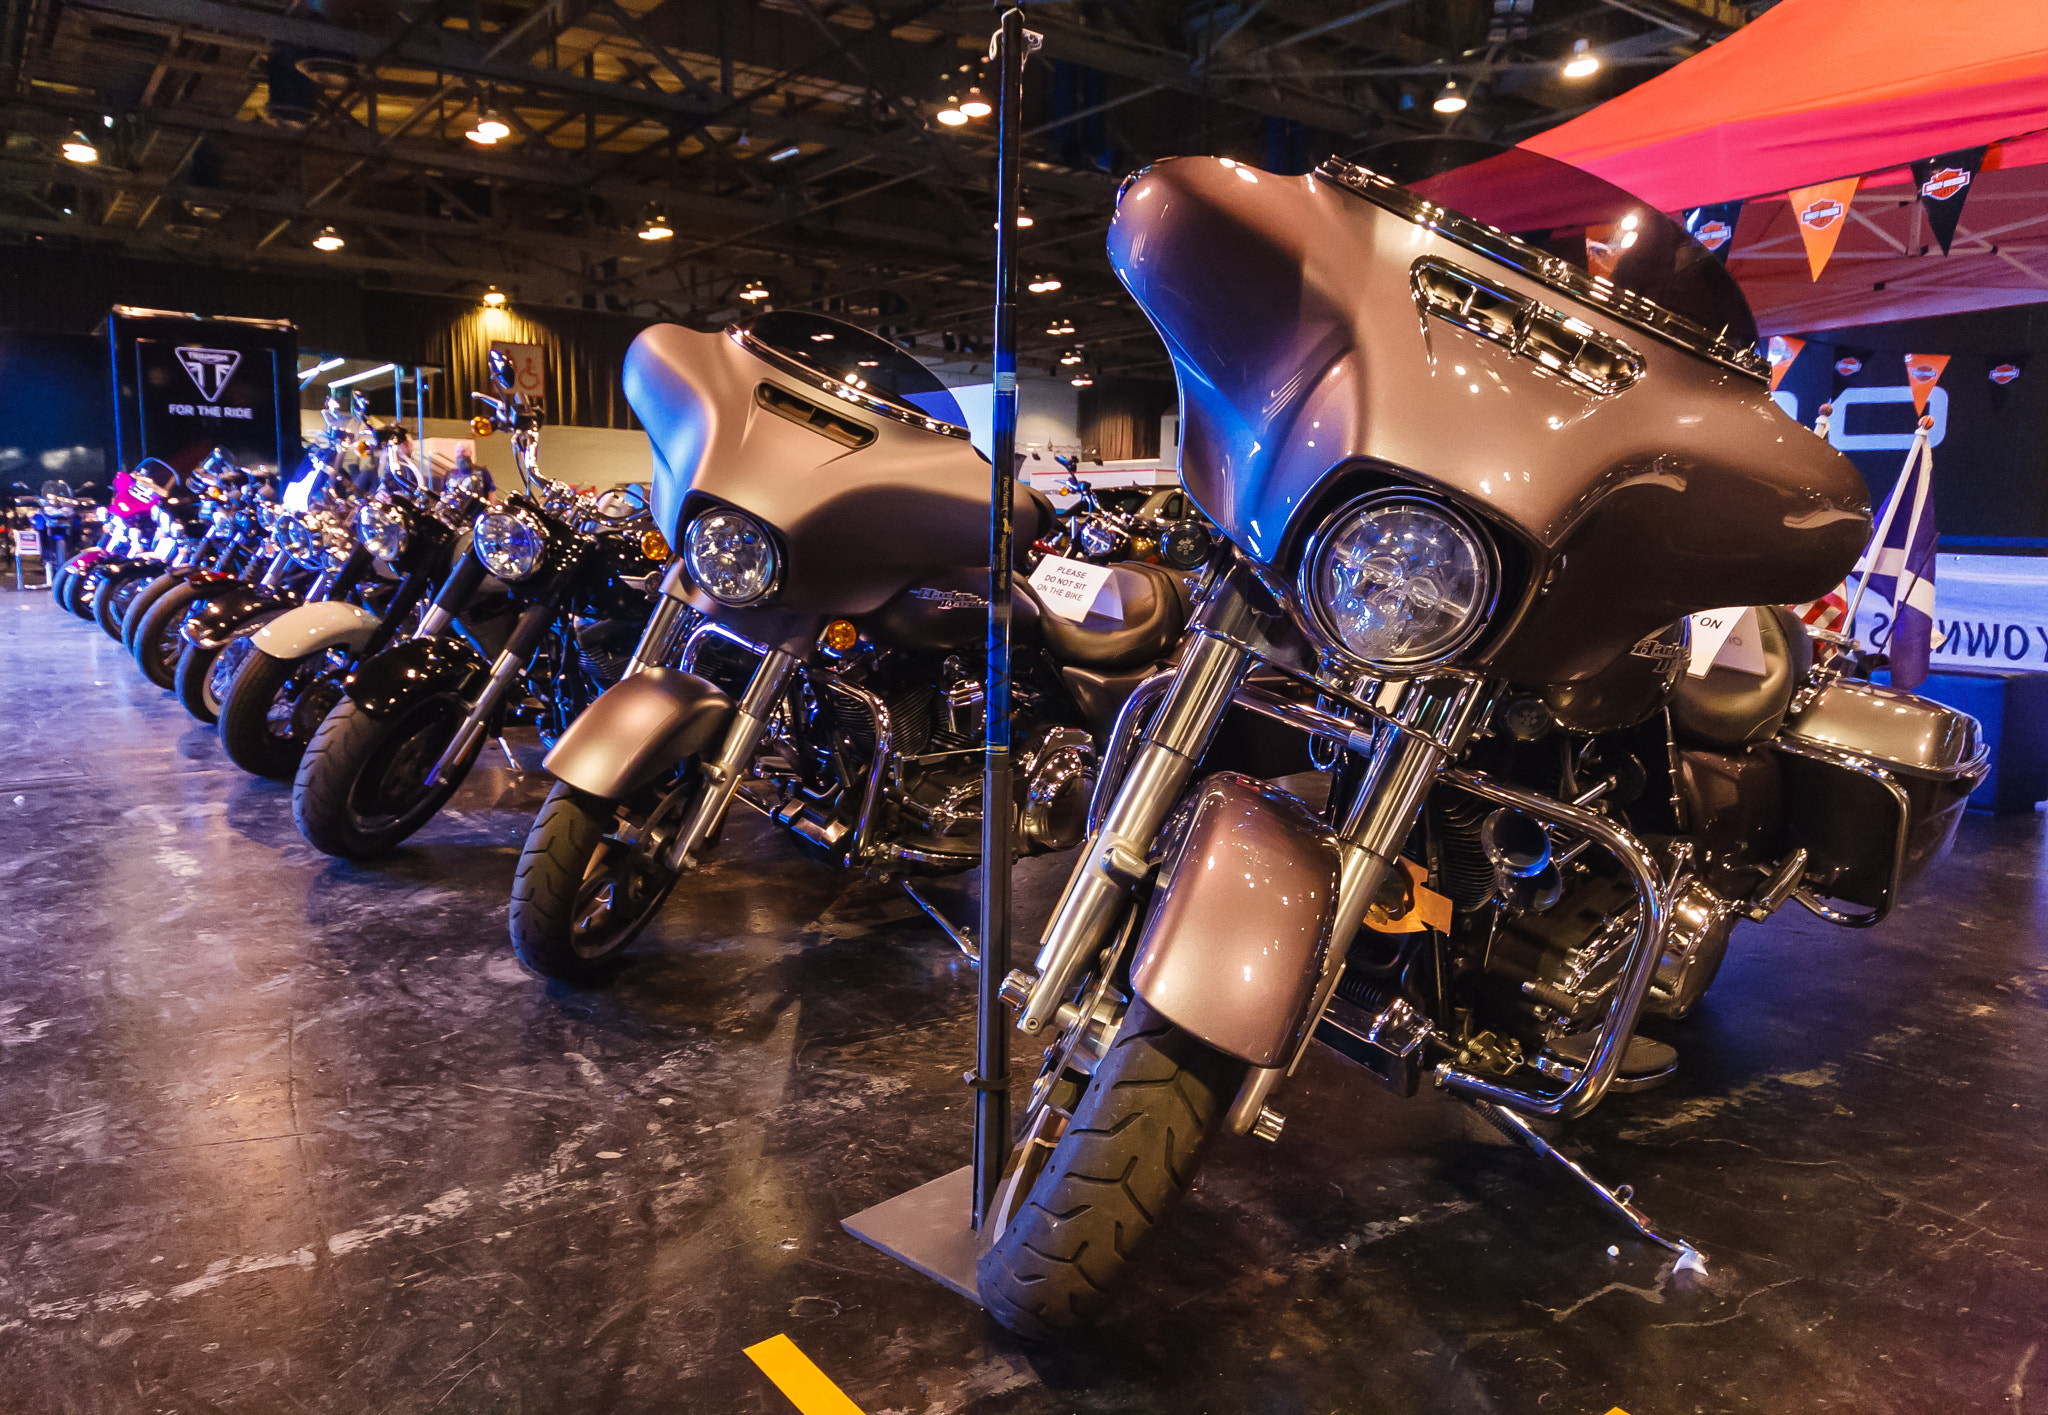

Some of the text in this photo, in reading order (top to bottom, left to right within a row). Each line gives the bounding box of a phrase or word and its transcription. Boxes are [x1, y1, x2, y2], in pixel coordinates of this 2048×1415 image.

[168, 403, 253, 420] FOR THE RIDE
[1056, 566, 1087, 579] PLEASE
[1044, 574, 1087, 591] DO NOT SIT
[1036, 583, 1084, 602] ON THE BIKE
[1700, 617, 1723, 629] ON
